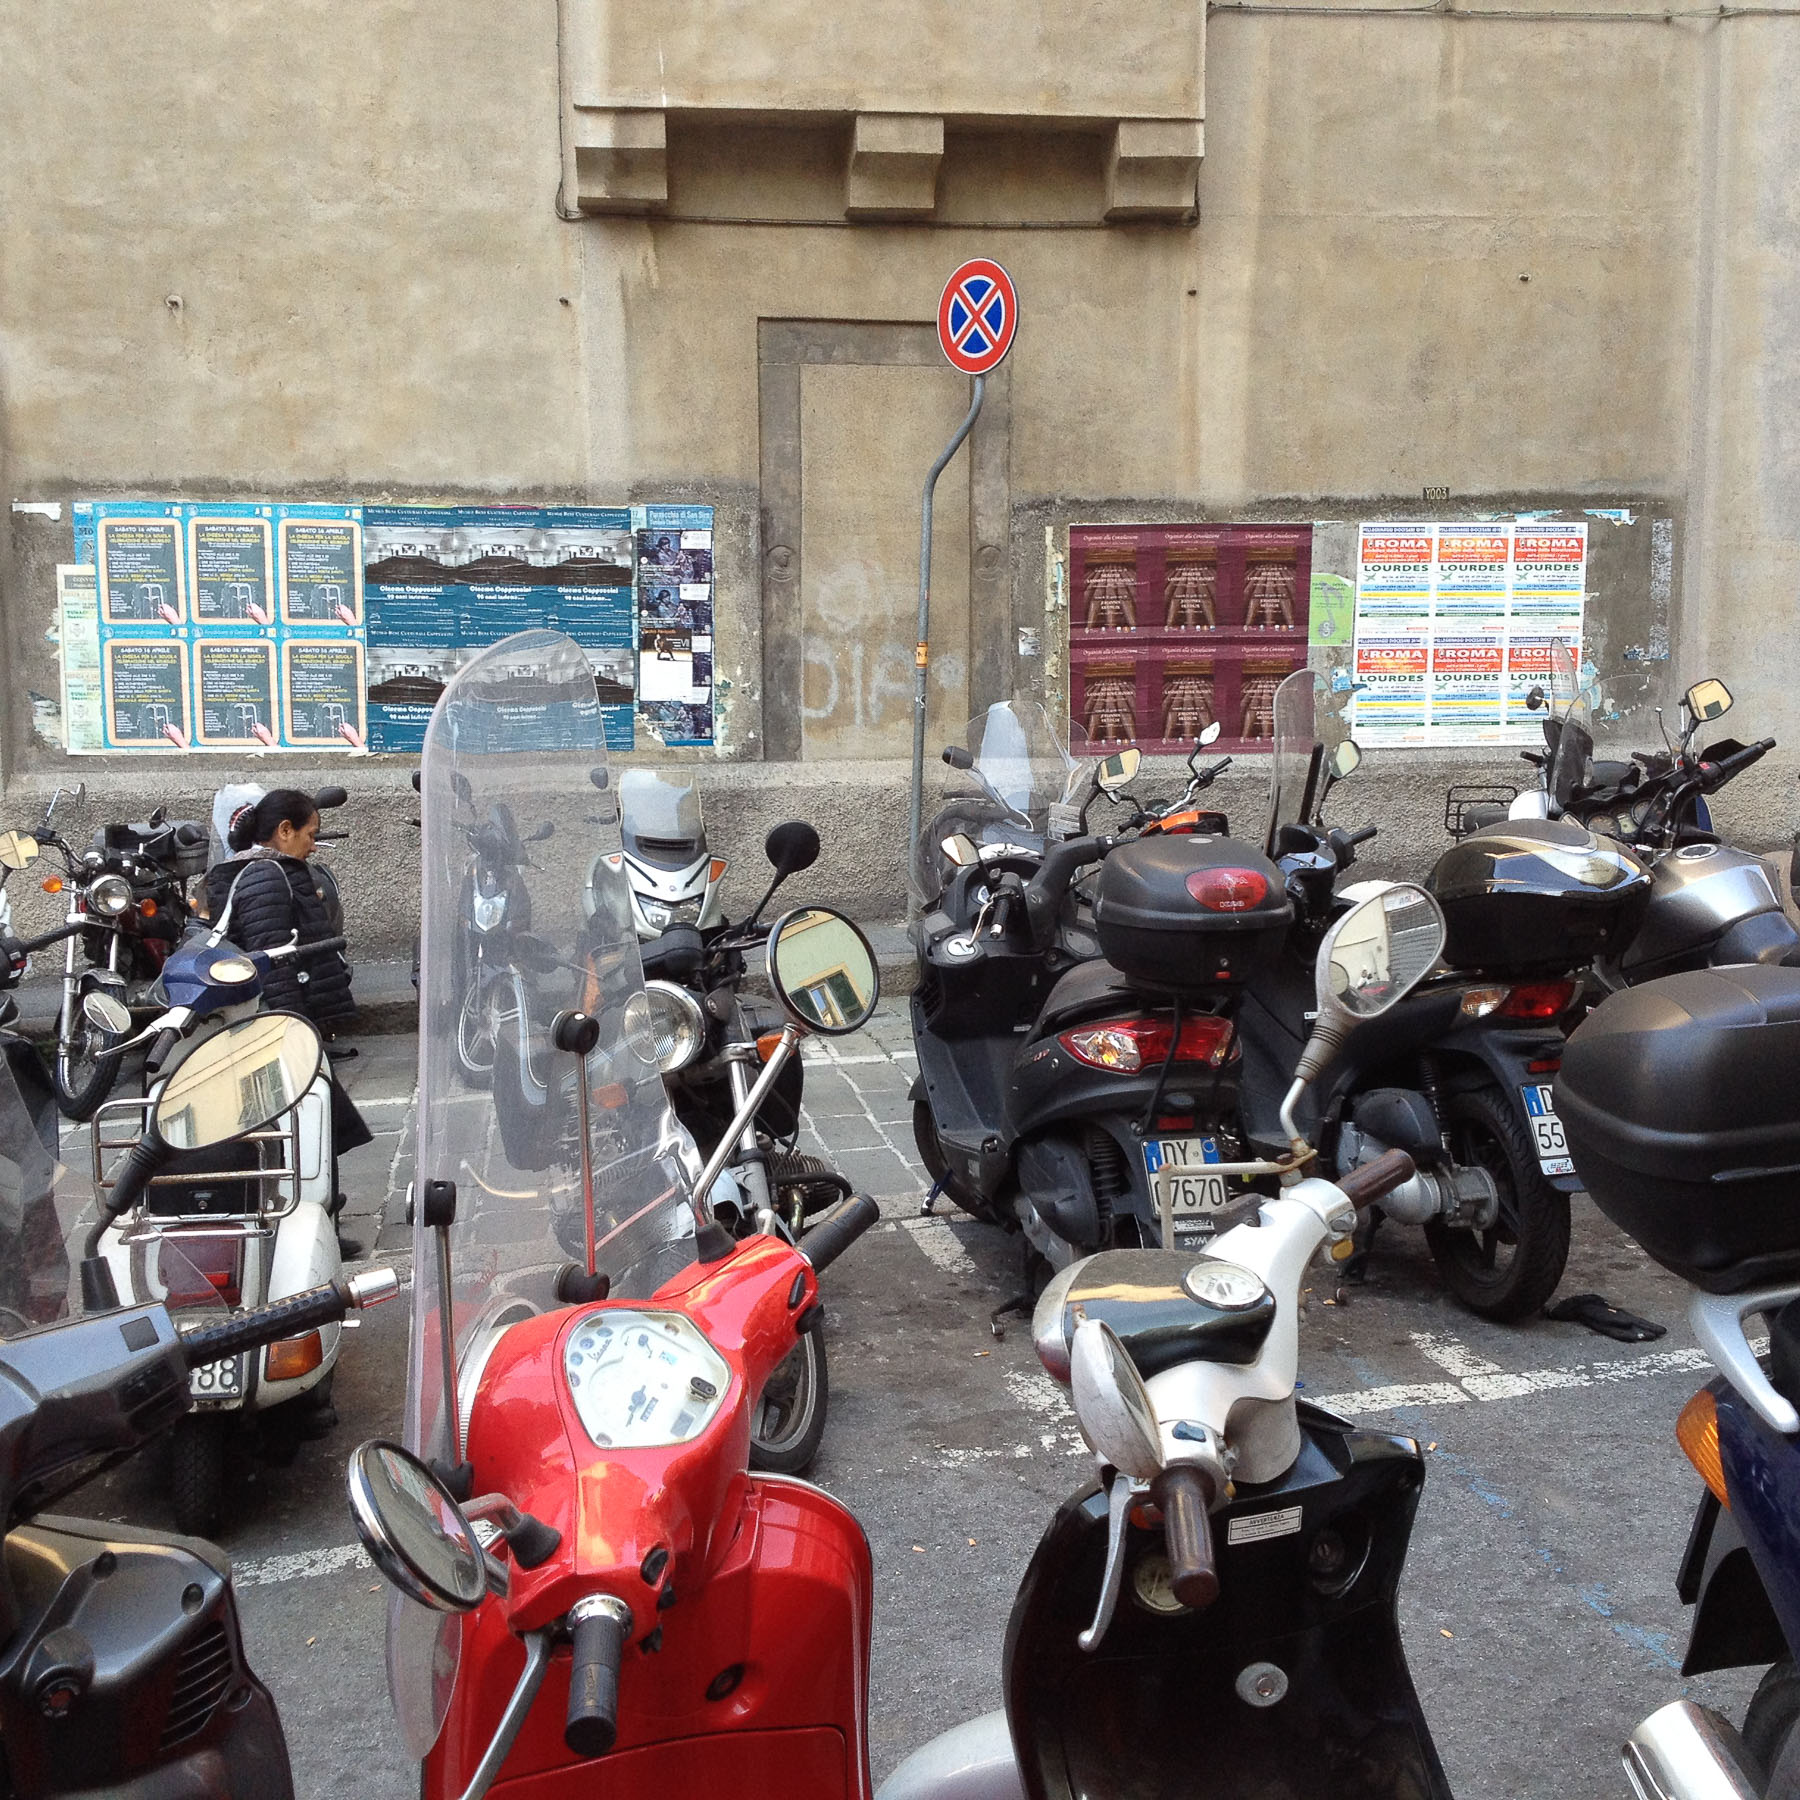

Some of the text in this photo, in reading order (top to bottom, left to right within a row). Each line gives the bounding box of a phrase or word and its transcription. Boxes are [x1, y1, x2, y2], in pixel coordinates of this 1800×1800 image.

[1425, 487, 1447, 500] Y003
[1374, 540, 1428, 548] ROMA
[1450, 540, 1505, 548] ROMA
[1526, 540, 1580, 548] ROMA
[1370, 650, 1424, 658] ROMA
[1446, 650, 1499, 658] ROMA
[1538, 1122, 1564, 1149] 55
[1162, 1140, 1188, 1166] DY
[1184, 1236, 1209, 1246] SYM
[1250, 1514, 1284, 1525] AVVERTENZA
